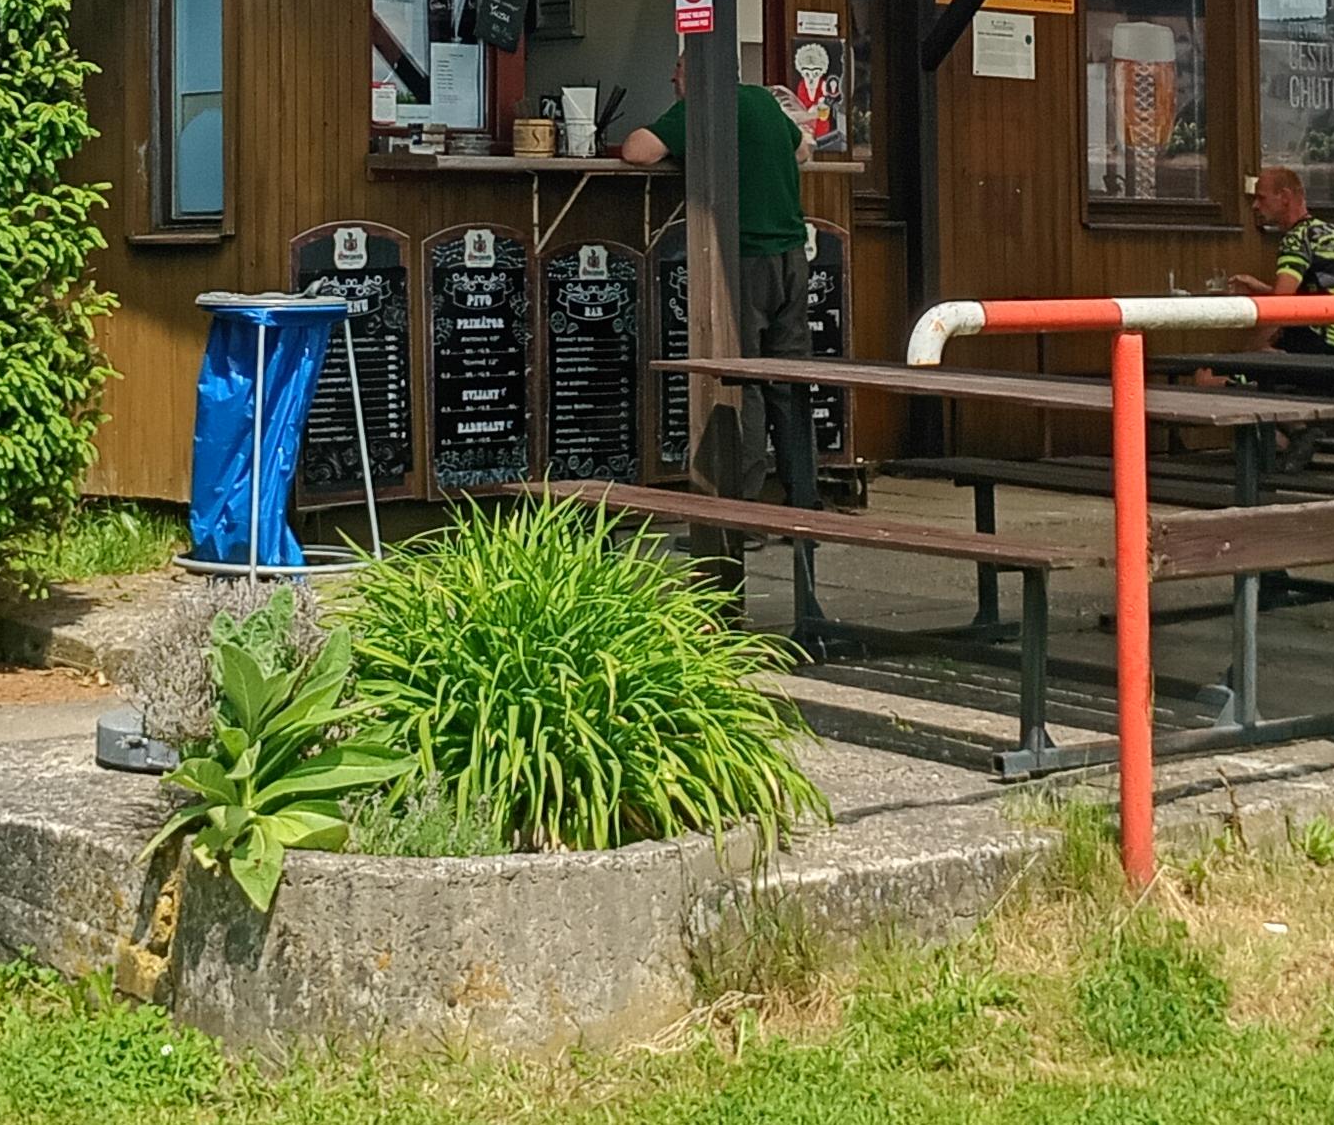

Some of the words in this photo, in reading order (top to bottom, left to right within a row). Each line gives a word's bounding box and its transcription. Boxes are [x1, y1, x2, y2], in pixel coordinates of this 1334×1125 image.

[346, 298, 369, 314] ENU
[467, 293, 492, 307] PIVO
[584, 306, 603, 317] BAR
[456, 315, 505, 330] PRIMÁTOR
